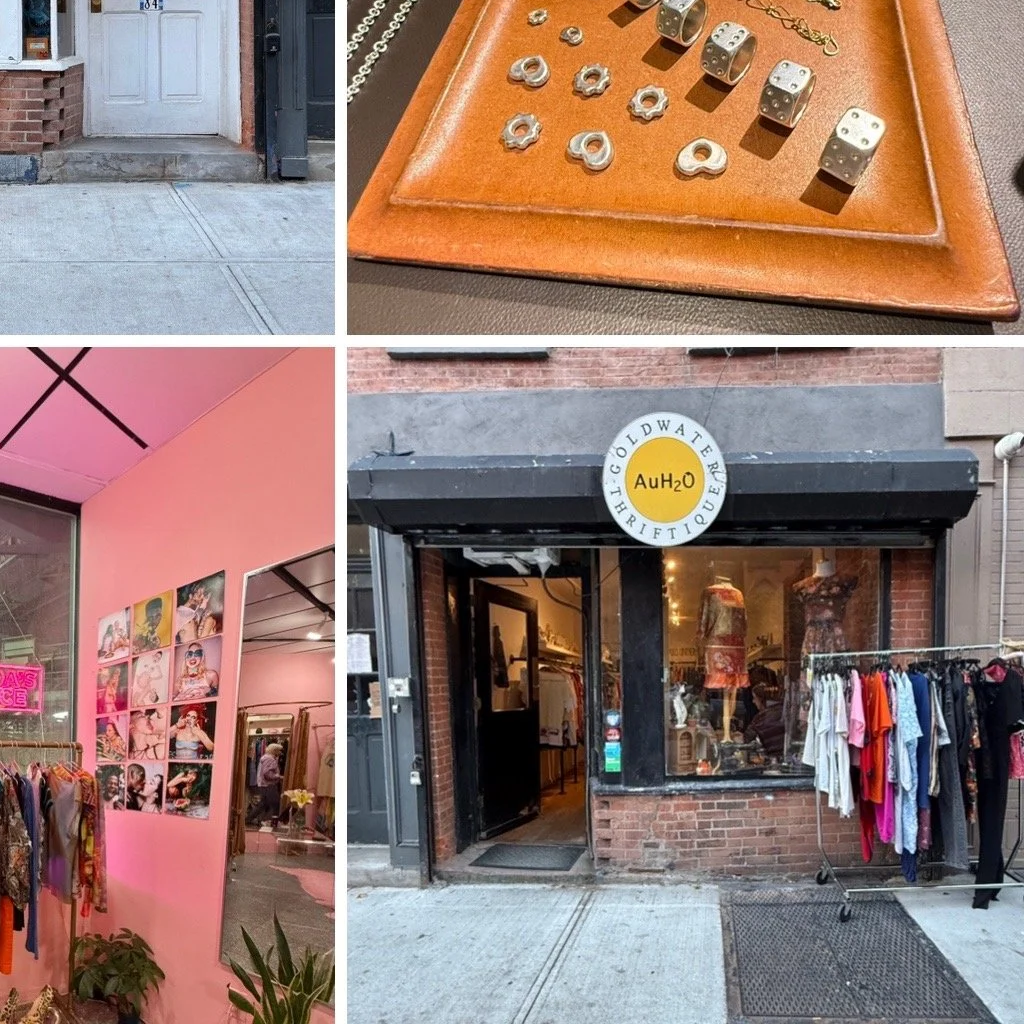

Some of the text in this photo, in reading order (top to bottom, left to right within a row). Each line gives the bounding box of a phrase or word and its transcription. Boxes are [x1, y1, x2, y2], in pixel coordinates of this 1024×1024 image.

[610, 420, 720, 477] GOLDWATER
[634, 472, 695, 492] AuH2O
[611, 486, 721, 540] THRIFTIQUE
